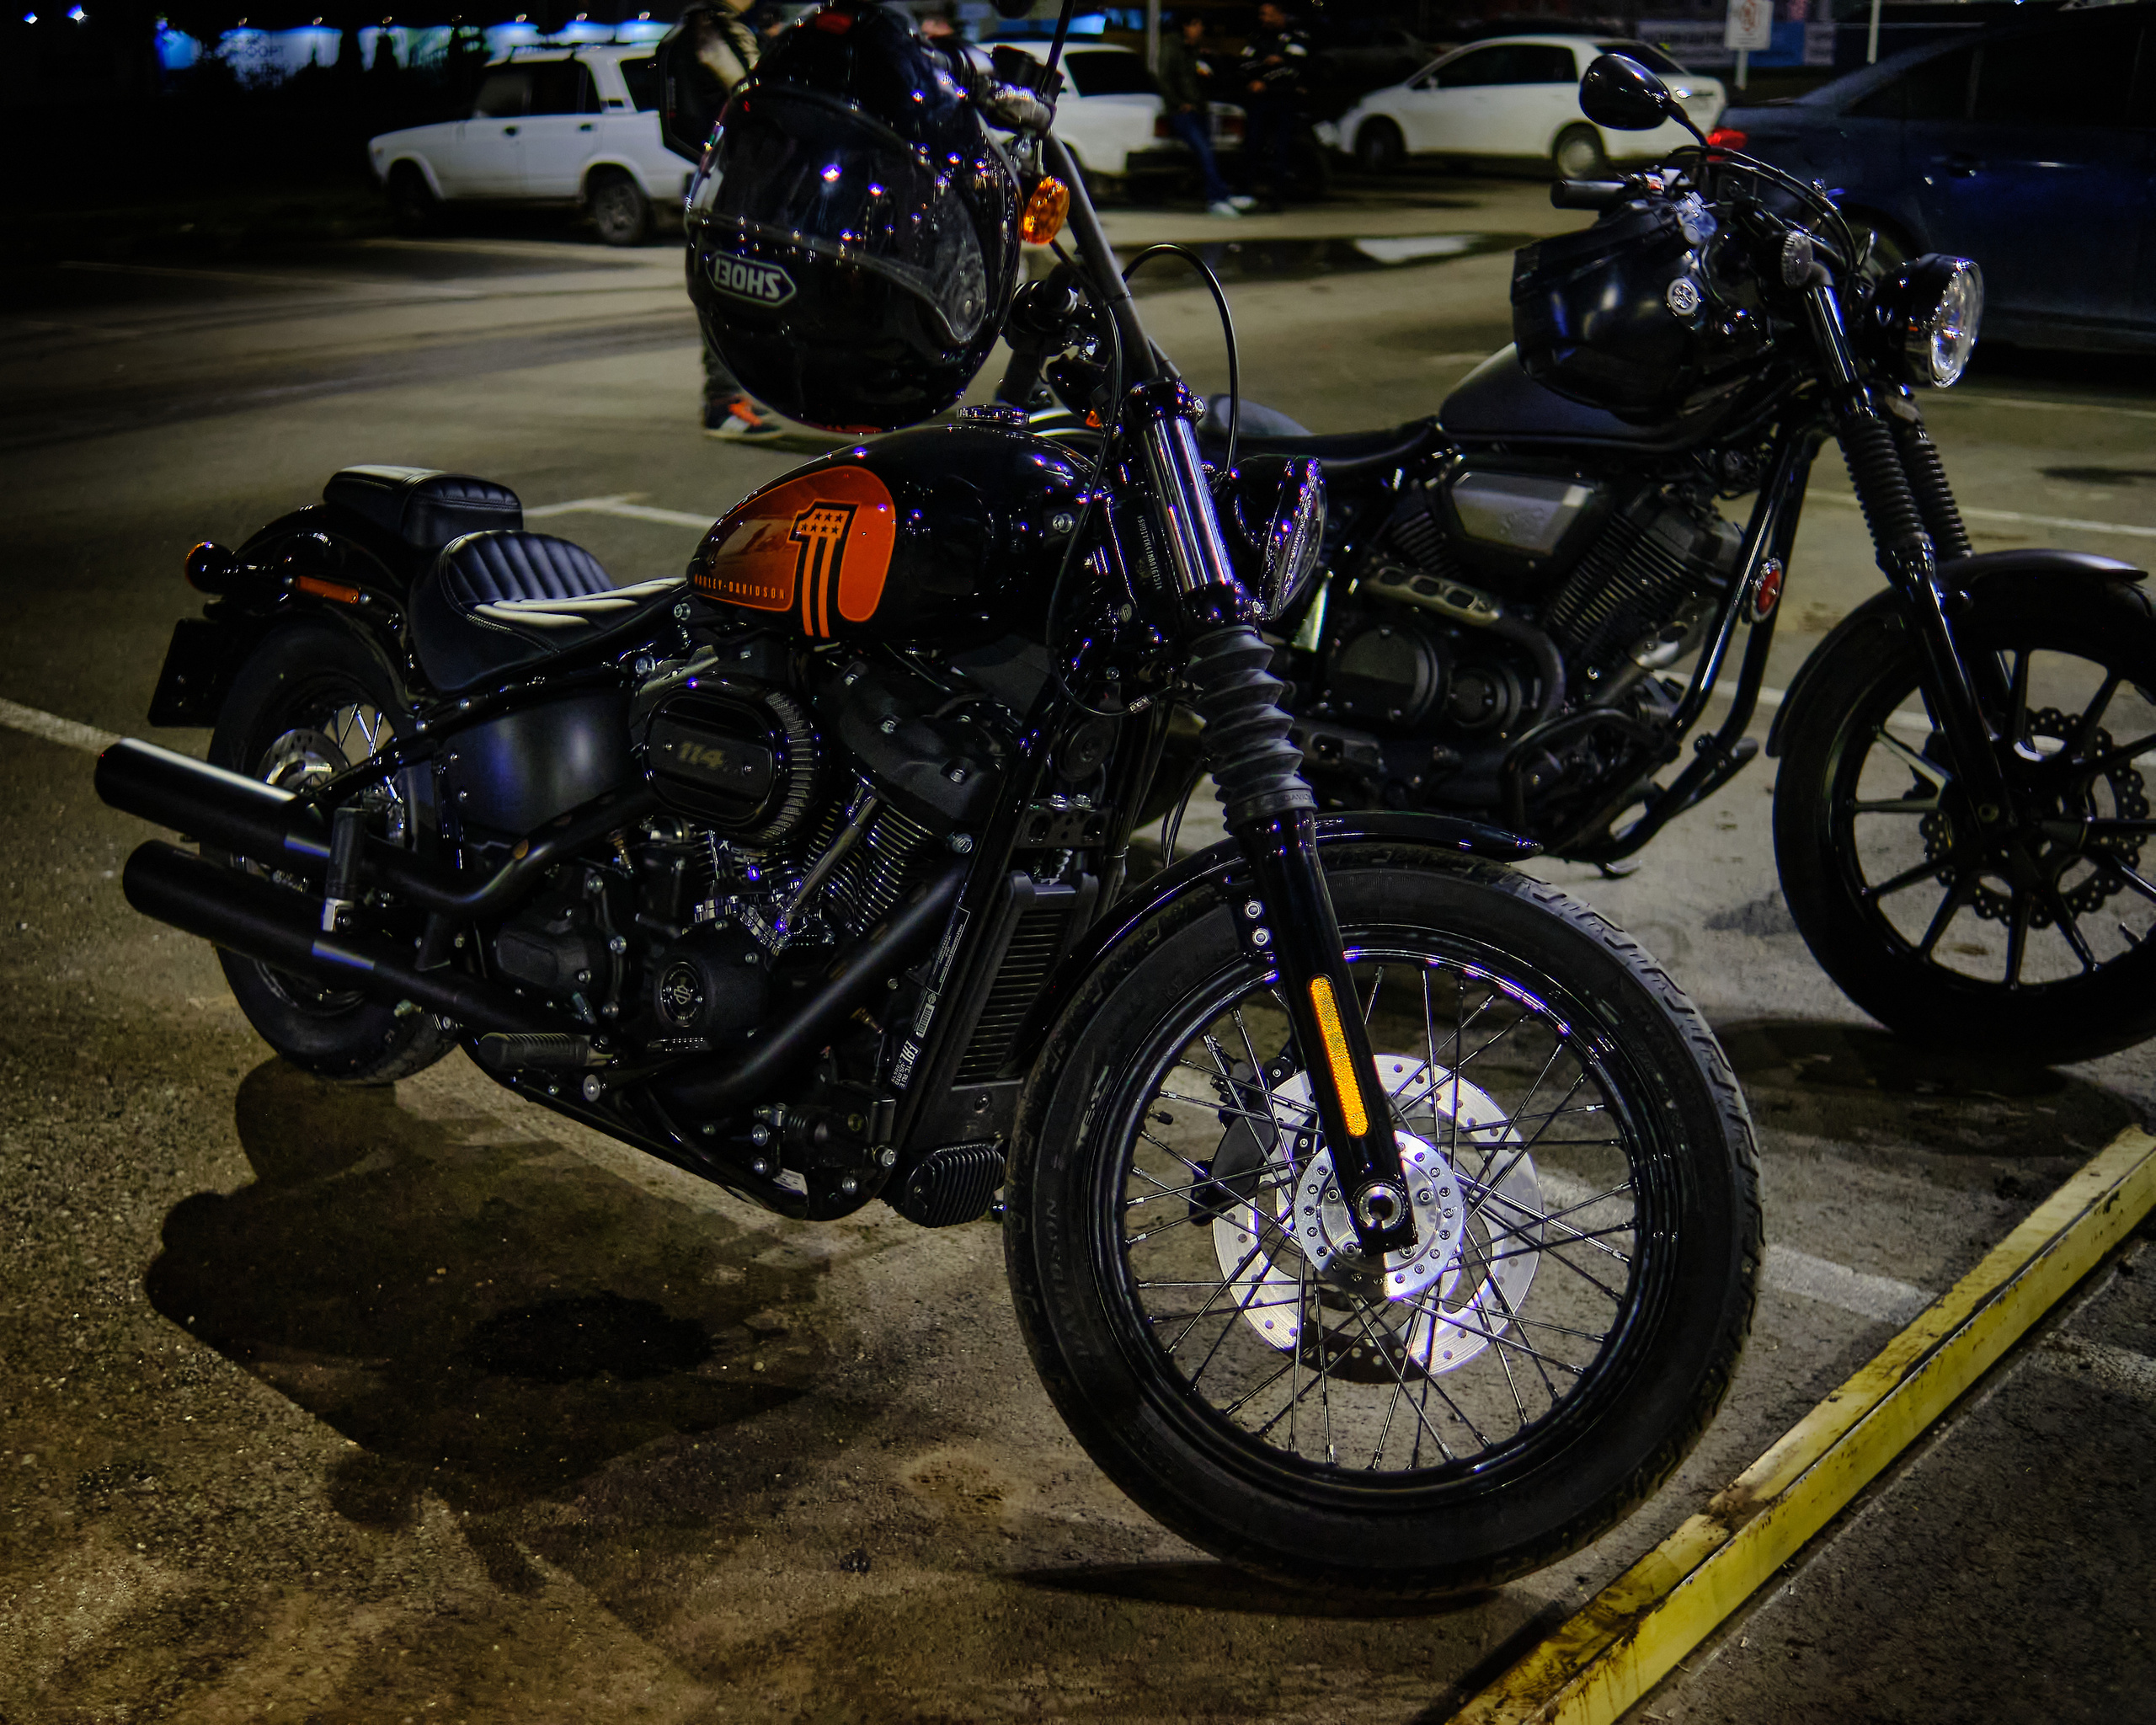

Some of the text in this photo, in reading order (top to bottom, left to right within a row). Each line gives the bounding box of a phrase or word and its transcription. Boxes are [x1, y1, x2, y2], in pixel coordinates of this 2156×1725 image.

[713, 256, 782, 301] SHOEI
[677, 740, 727, 771] 114
[899, 1039, 919, 1065] EAC
